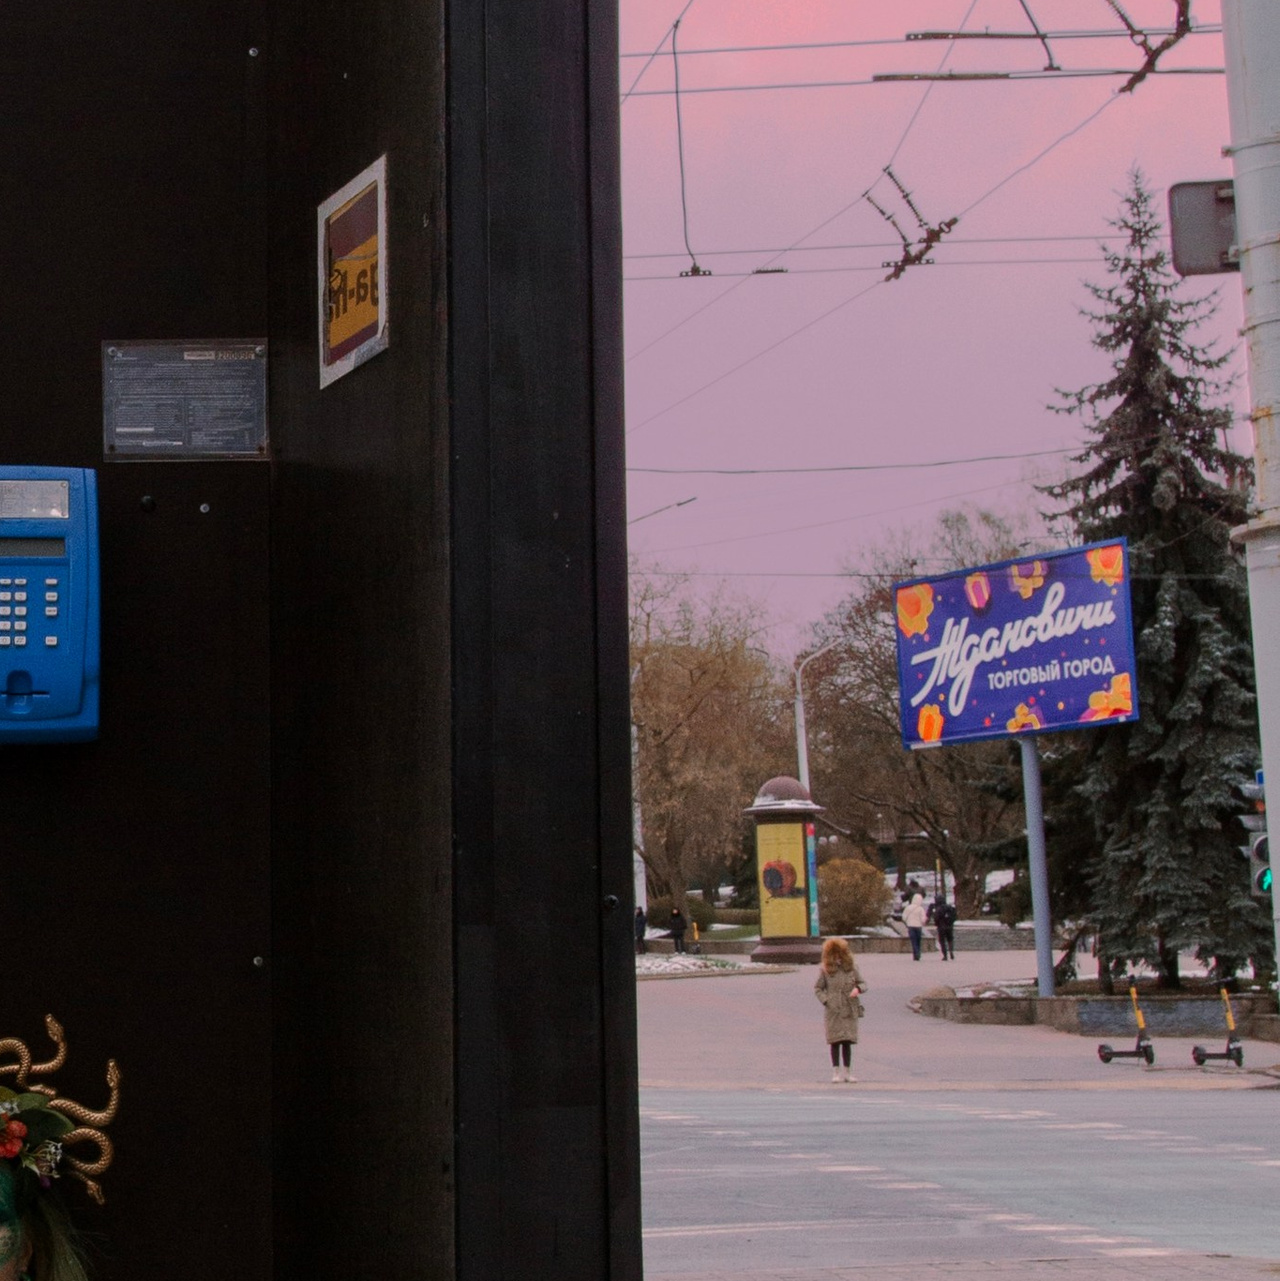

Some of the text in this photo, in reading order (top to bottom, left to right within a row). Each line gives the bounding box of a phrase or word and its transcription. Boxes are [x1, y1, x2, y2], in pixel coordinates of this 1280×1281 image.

[910, 582, 1116, 716] Ждановичи
[988, 655, 1115, 690] ТОРГОВЫЙ ГОРОД
